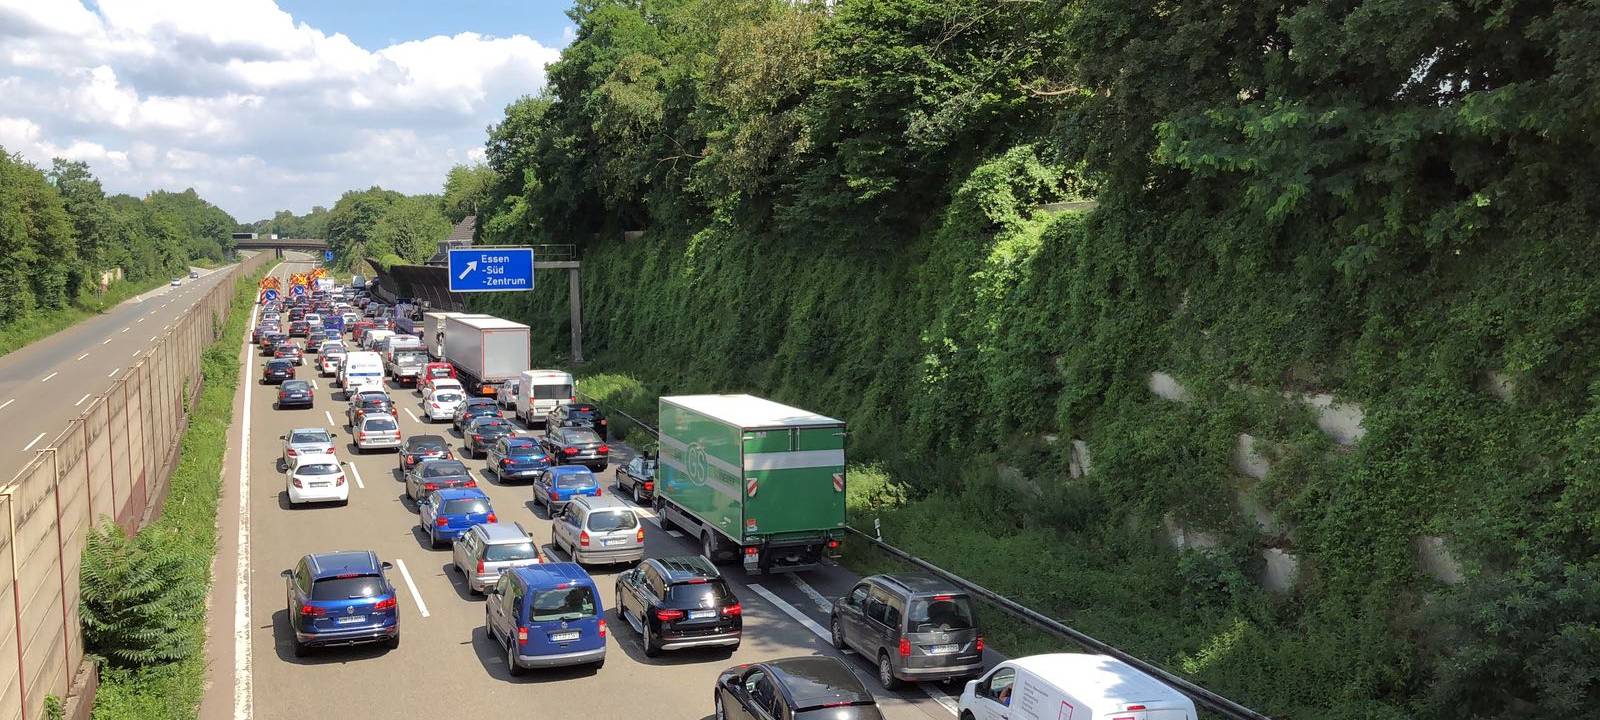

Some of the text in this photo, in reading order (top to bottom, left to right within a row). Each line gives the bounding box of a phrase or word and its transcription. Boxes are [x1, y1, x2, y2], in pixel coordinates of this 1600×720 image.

[481, 254, 510, 263] Essen
[482, 266, 504, 274] -Süd
[483, 277, 526, 285] -Zentrum
